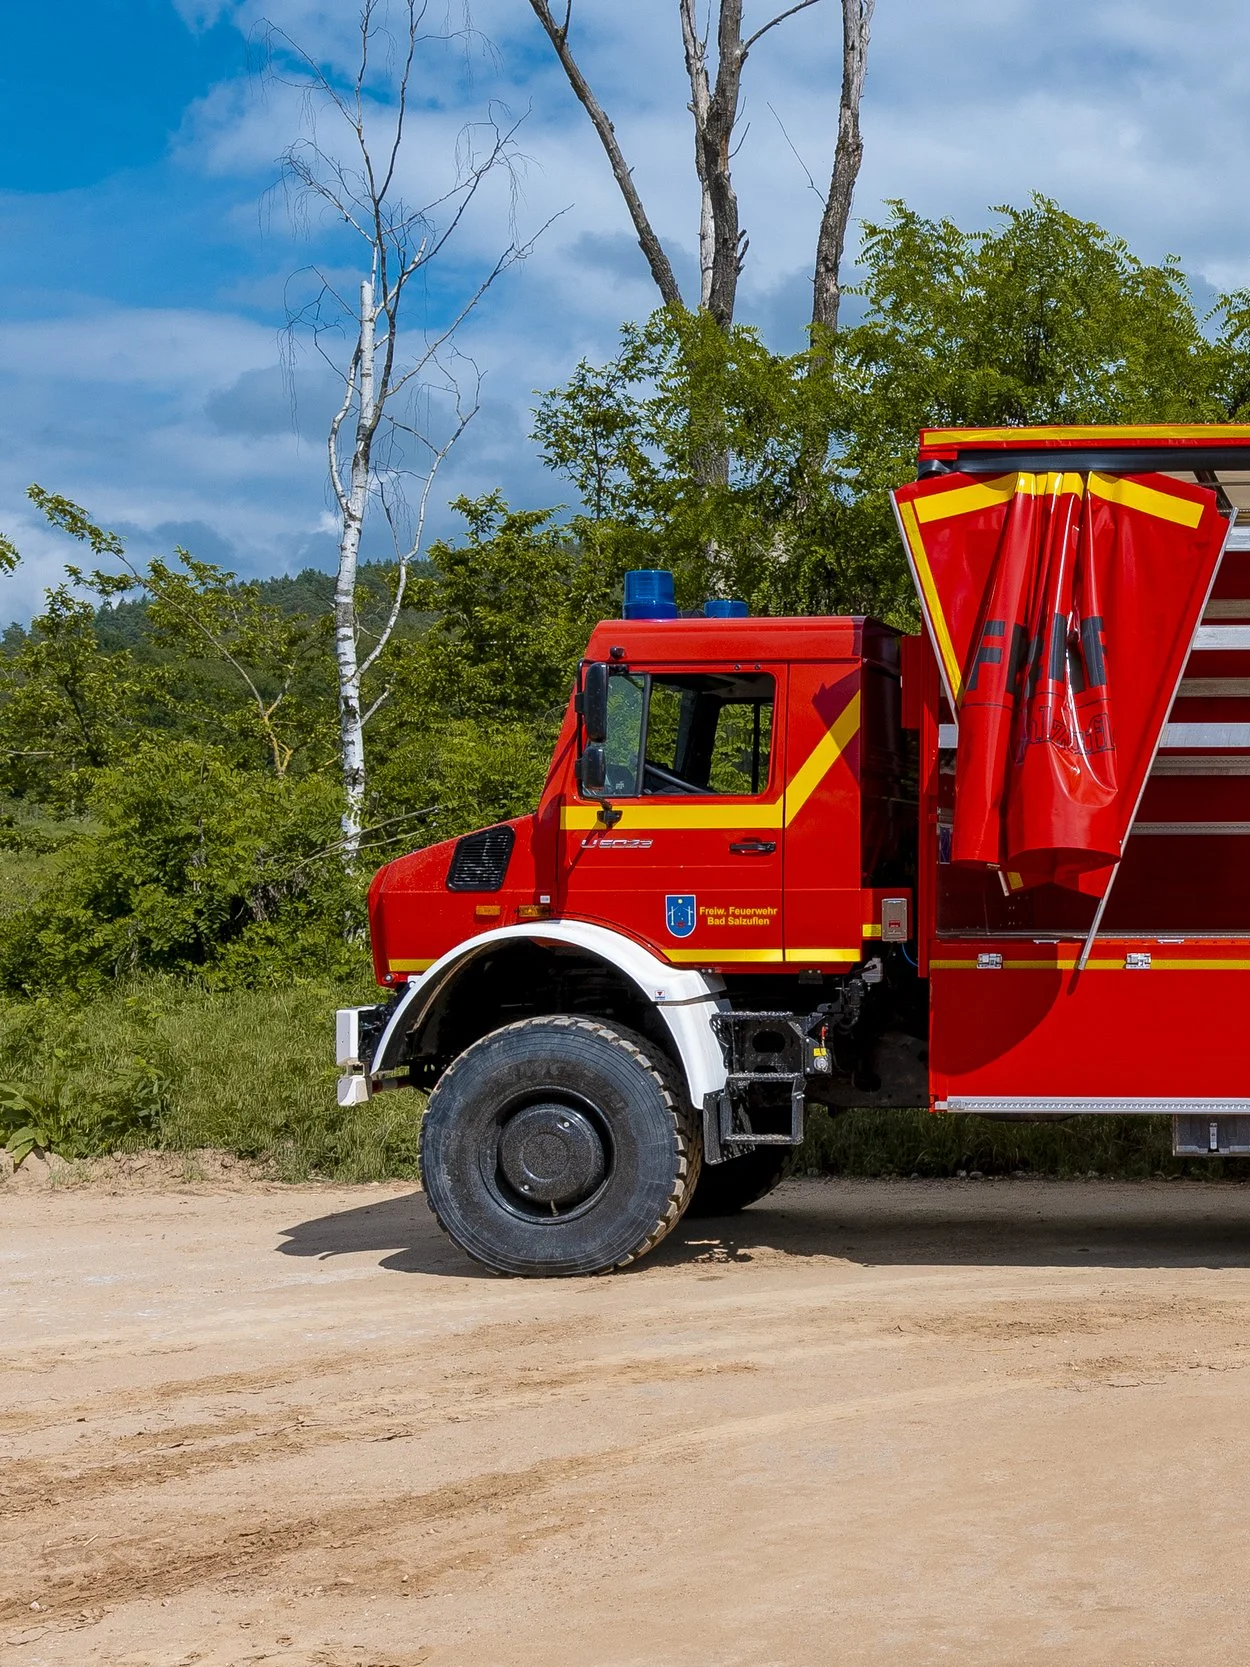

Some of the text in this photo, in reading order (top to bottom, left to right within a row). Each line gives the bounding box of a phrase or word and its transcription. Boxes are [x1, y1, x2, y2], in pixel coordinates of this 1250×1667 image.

[699, 906, 778, 915] Freiw. Feuerwehr
[707, 916, 770, 926] Bad Salzuflen
